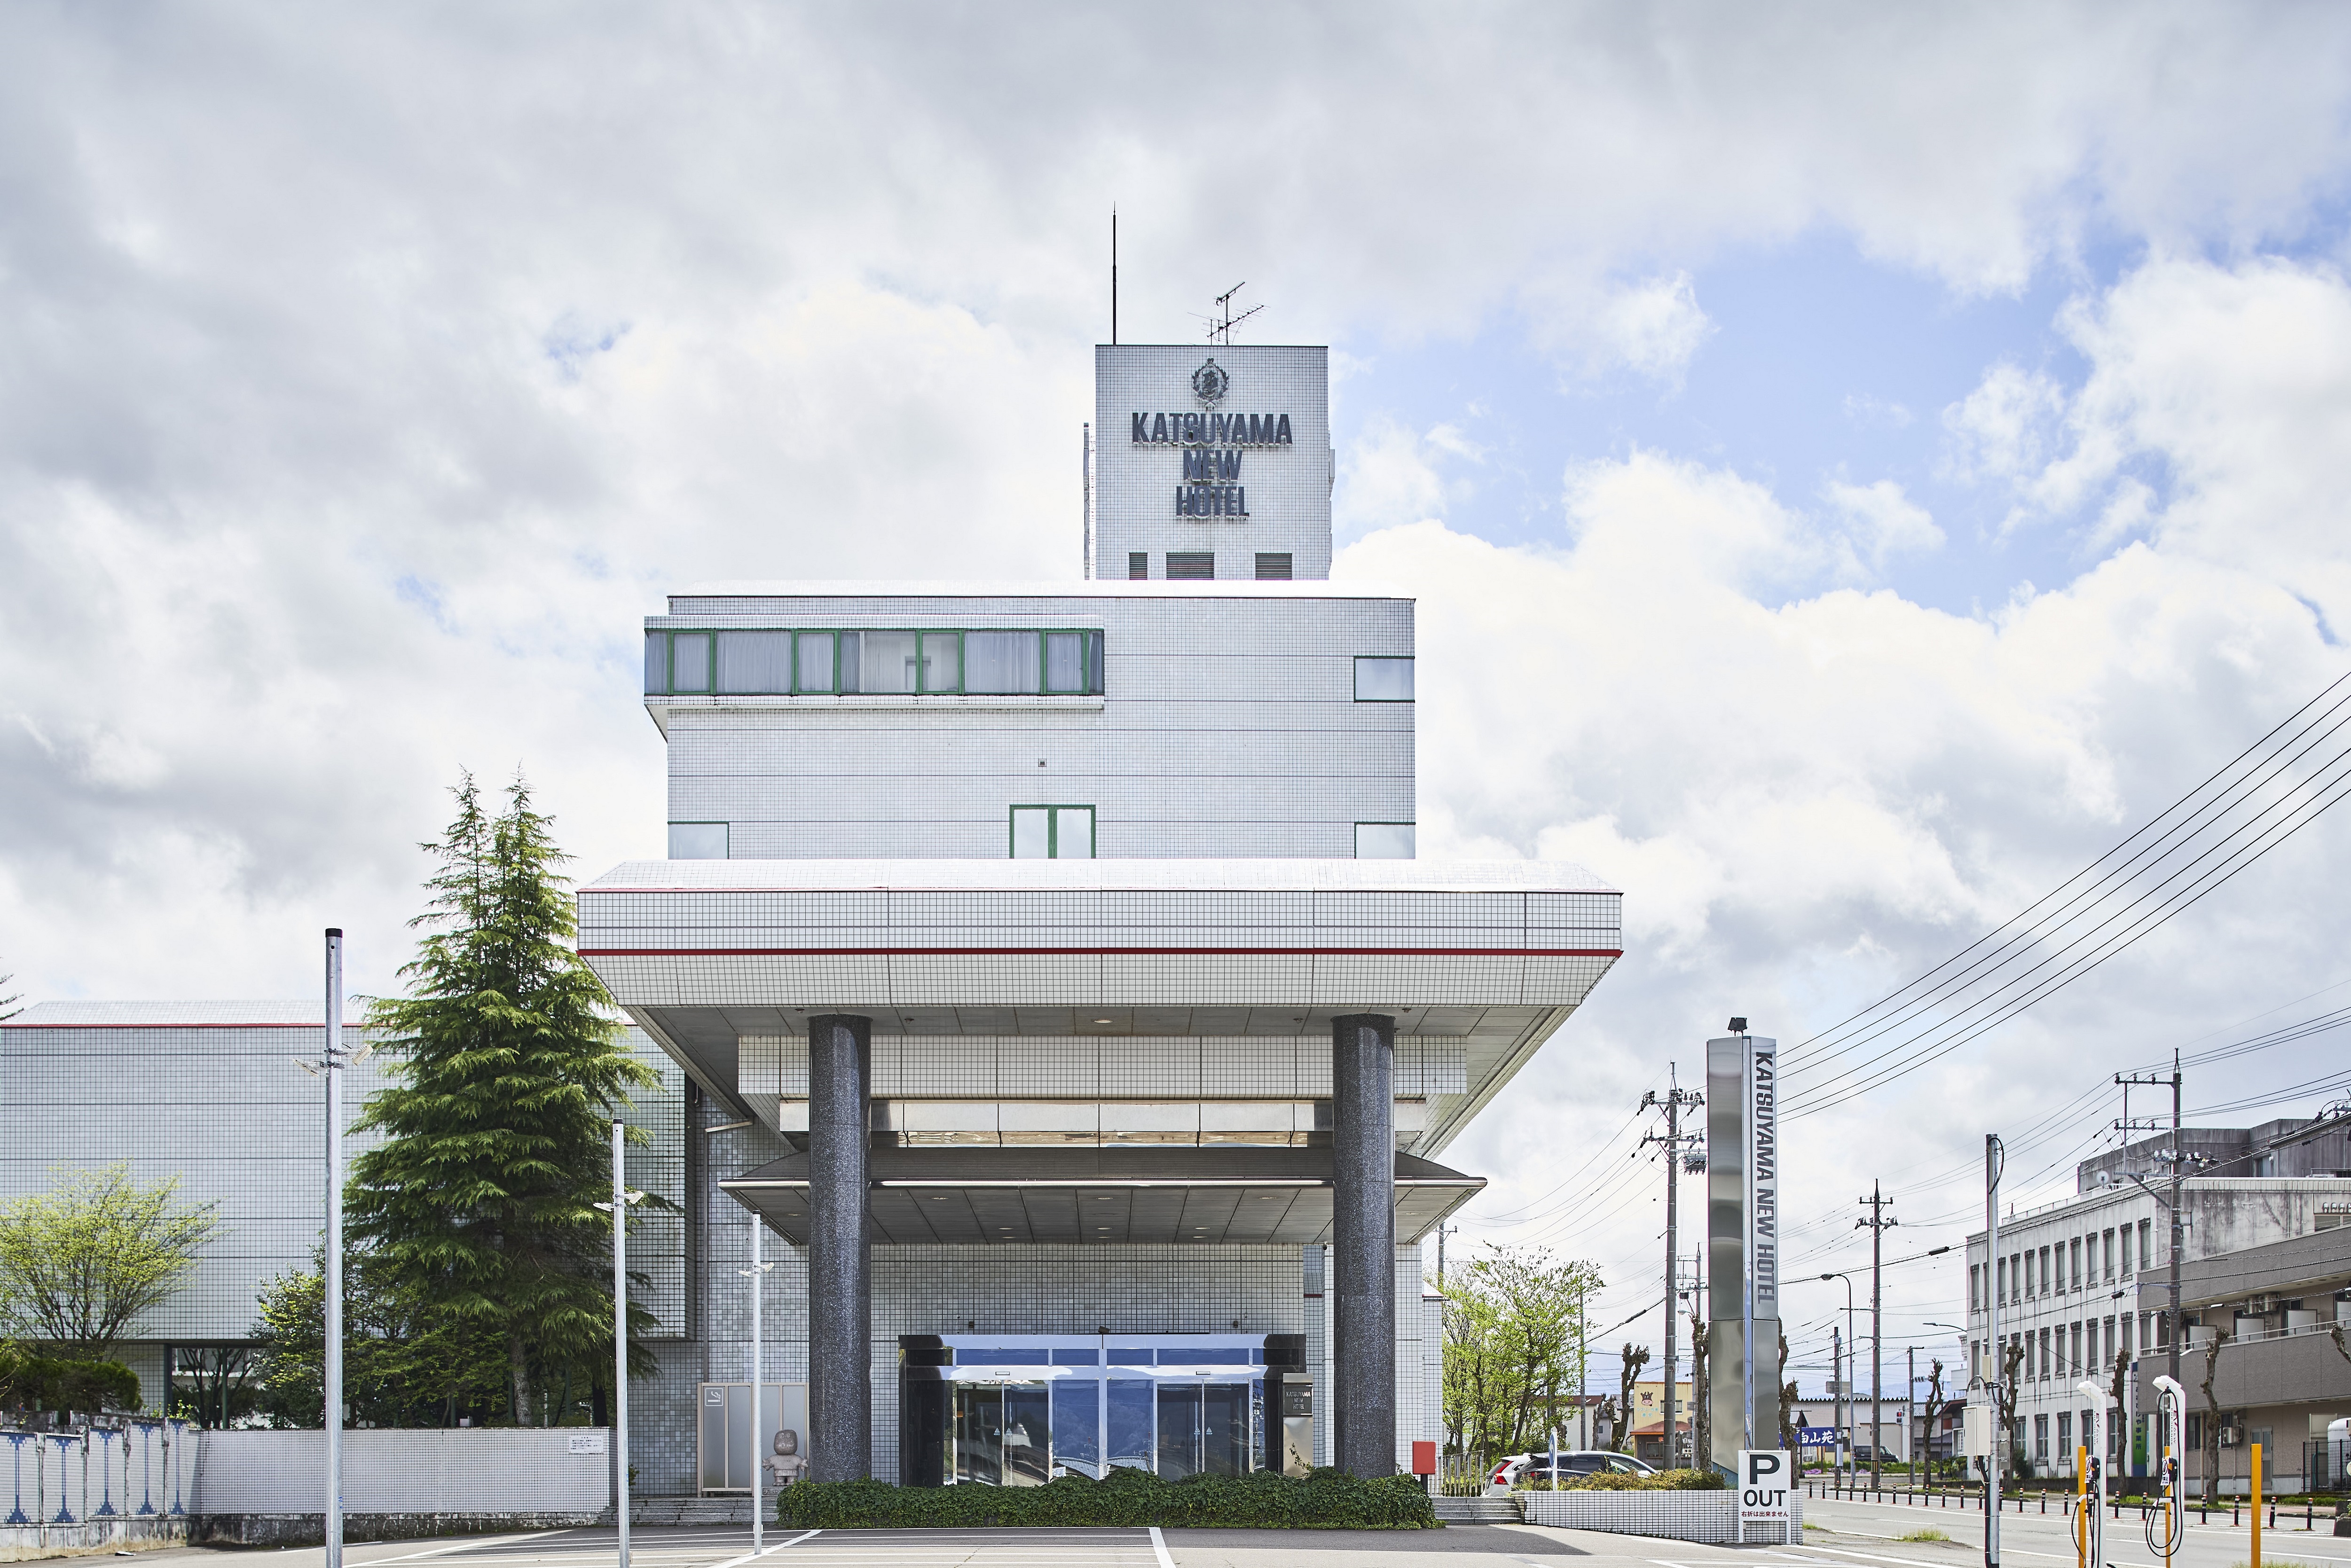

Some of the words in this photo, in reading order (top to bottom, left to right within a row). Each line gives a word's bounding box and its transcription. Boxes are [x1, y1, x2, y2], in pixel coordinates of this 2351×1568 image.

[1132, 412, 1293, 446] KATSUYAMA
[1183, 450, 1242, 481] NEW
[1176, 486, 1250, 518] HOTEL
[1756, 1051, 1774, 1181] KATSUYAMA
[1756, 1189, 1774, 1238] NEW
[1757, 1244, 1775, 1304] HOTEL
[1749, 1454, 1780, 1484] P
[1744, 1490, 1786, 1507] OUT
